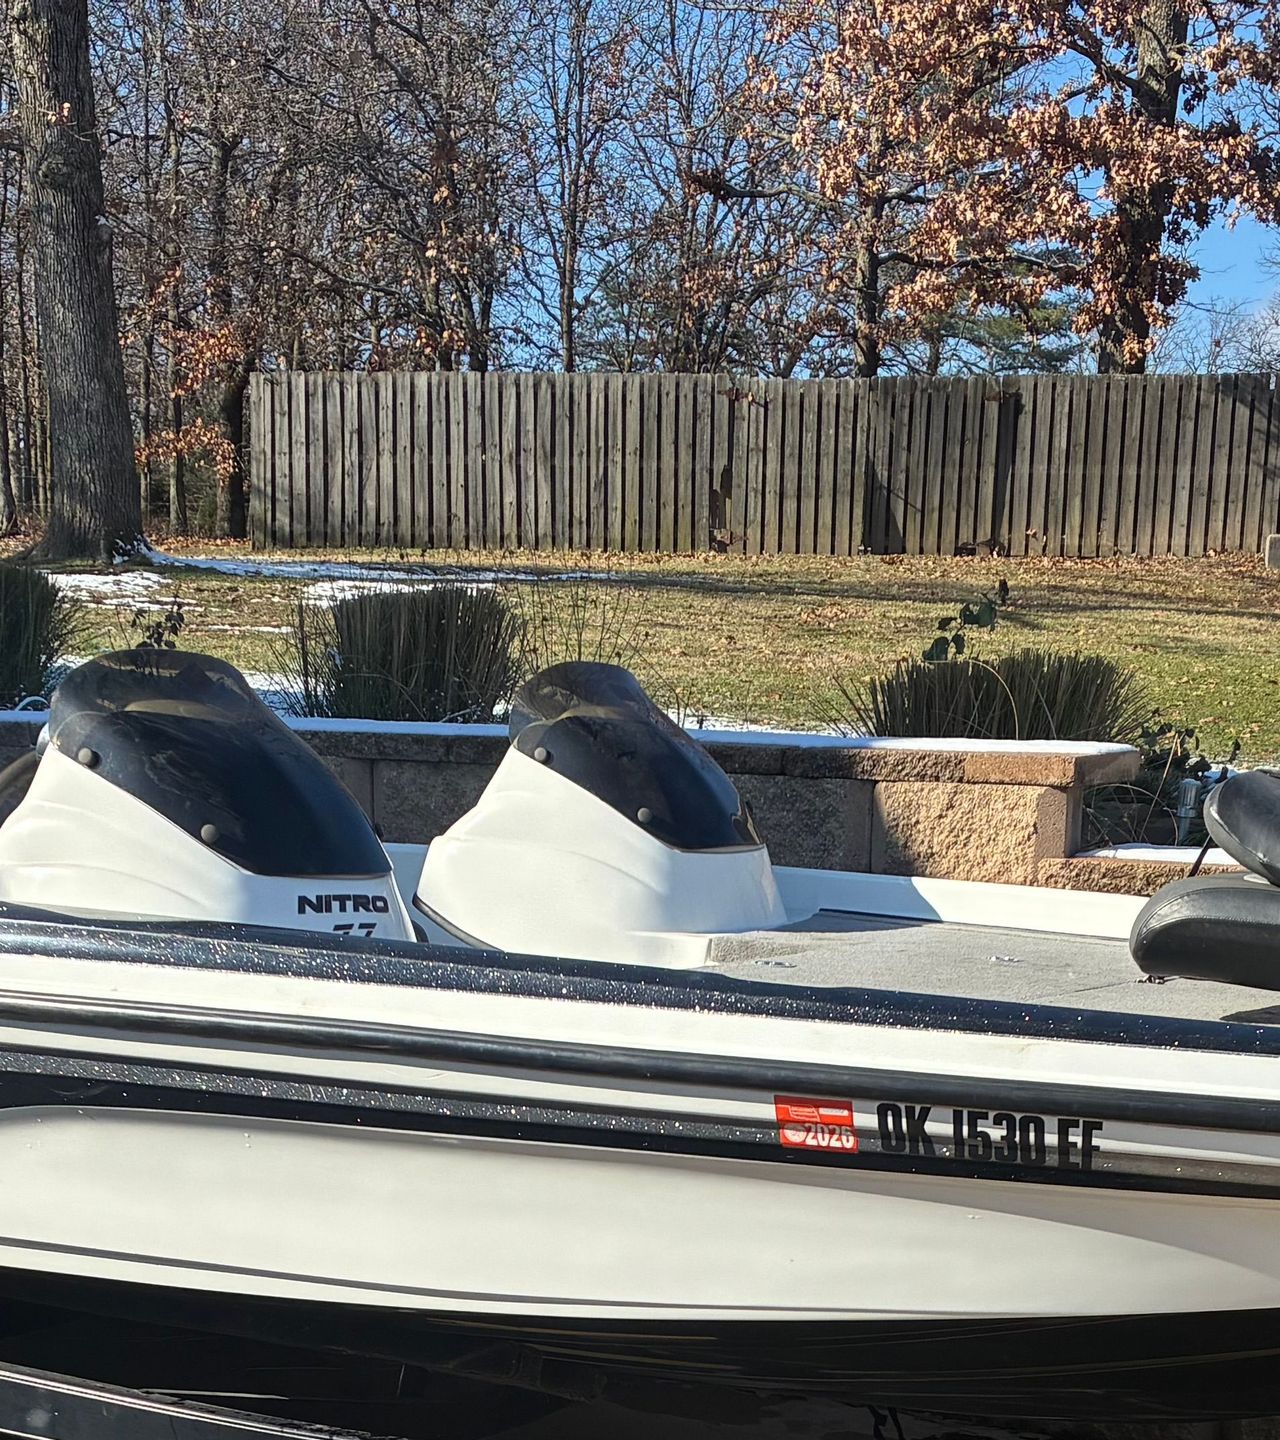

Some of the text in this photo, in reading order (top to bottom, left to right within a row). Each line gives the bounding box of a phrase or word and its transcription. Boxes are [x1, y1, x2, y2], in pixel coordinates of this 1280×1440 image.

[297, 894, 389, 915] NITRO
[804, 1122, 855, 1149] 2026
[876, 1102, 1103, 1169] OK 1530 EF
